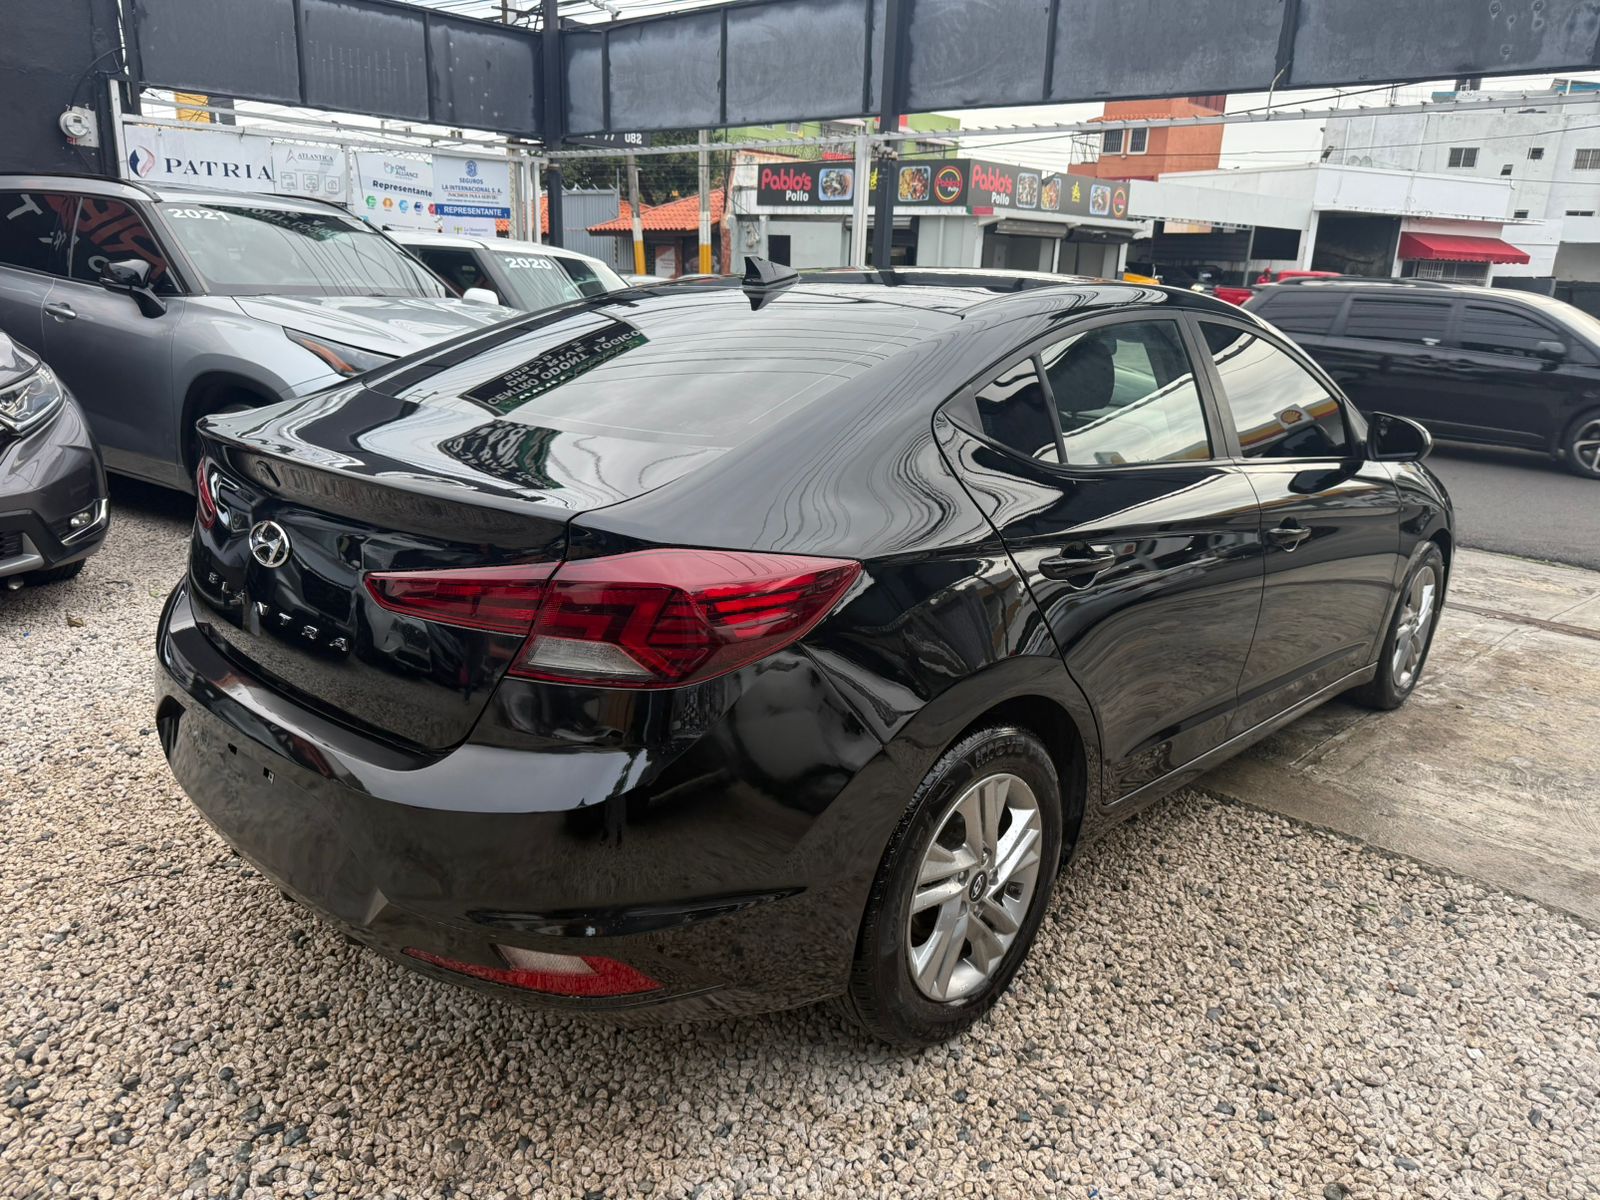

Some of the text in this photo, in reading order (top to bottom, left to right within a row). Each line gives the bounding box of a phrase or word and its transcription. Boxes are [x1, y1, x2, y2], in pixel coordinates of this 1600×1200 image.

[164, 157, 272, 180] PATRIA
[459, 177, 483, 185] SEGUROS
[761, 168, 813, 191] Pablo's
[971, 164, 1013, 195] Pablo's
[372, 180, 433, 197] Representante
[449, 184, 490, 193] INTERNACIONAL
[785, 190, 809, 202] Pollo
[991, 192, 1010, 206] Pollo
[167, 208, 231, 221] 2021
[443, 205, 502, 215] REPRESENTANTE
[504, 257, 553, 270] 2020
[208, 571, 349, 652] ELANTRA
